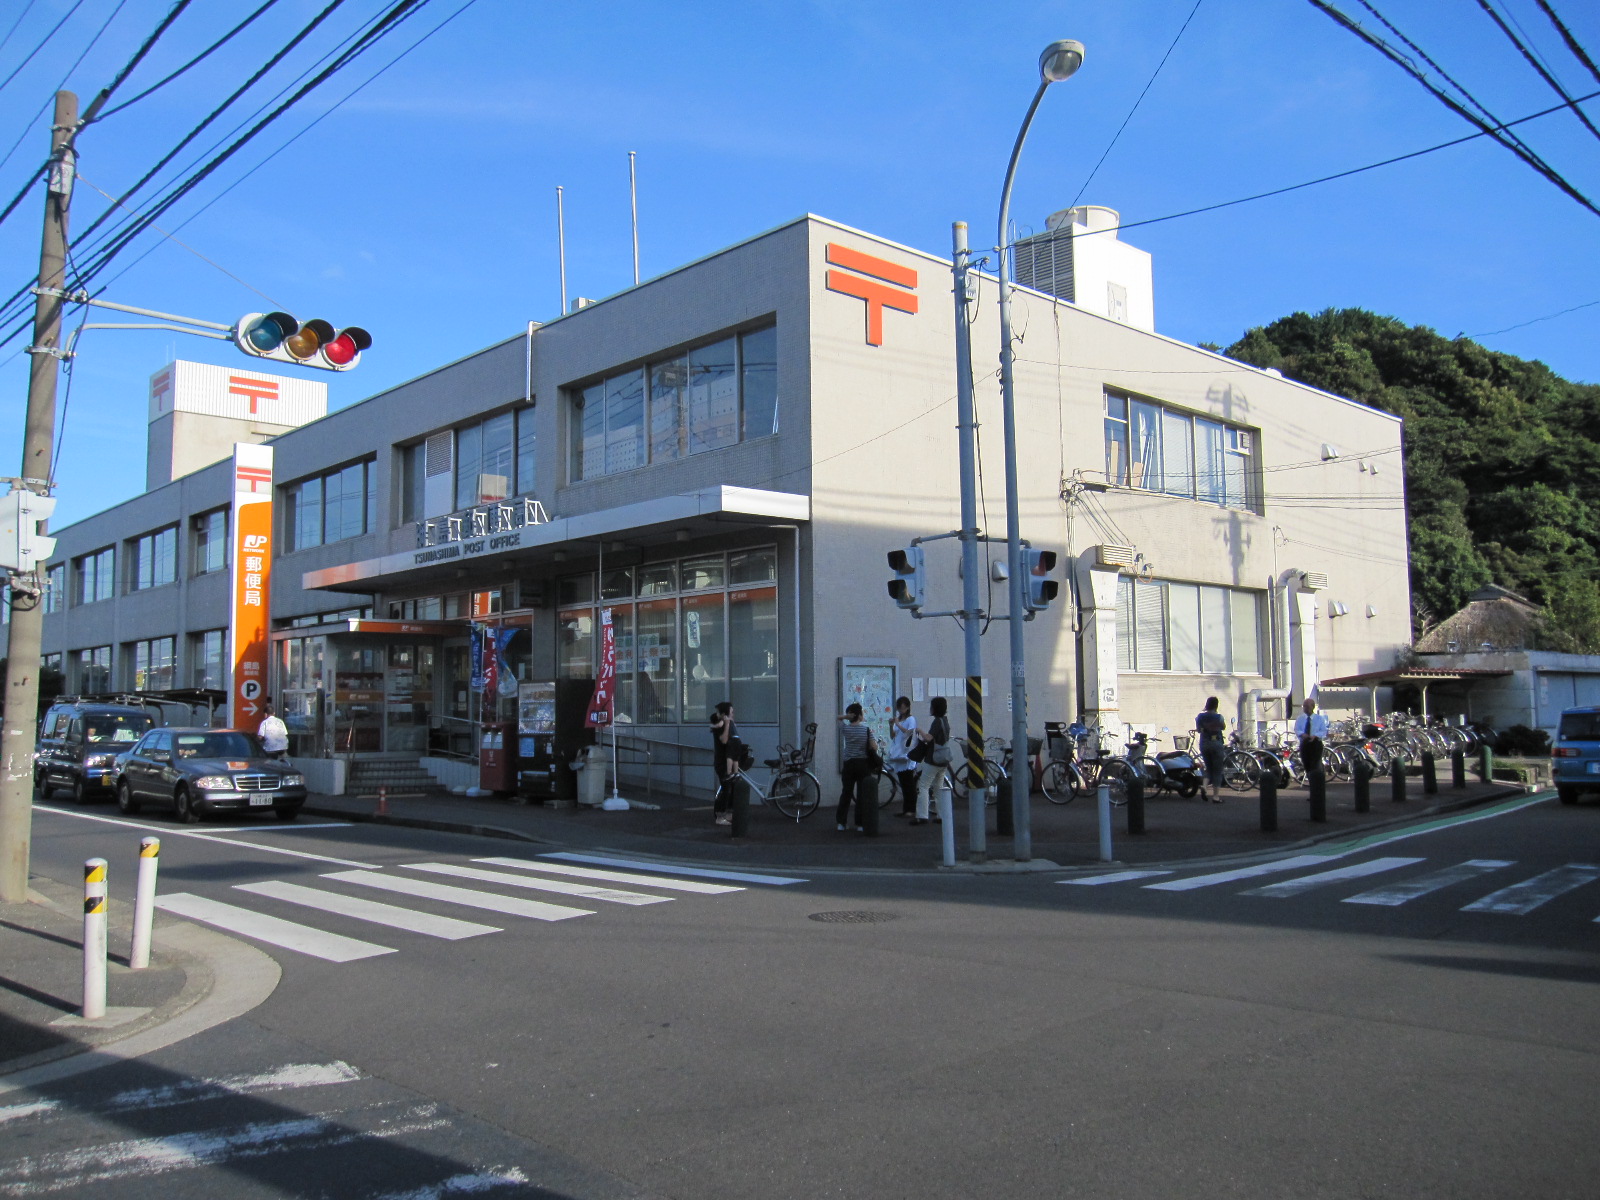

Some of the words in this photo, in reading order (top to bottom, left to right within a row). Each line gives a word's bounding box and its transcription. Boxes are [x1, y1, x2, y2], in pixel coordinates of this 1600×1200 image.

[413, 545, 460, 564] TSUNASHIMA
[463, 540, 486, 554] POST
[489, 533, 520, 550] OFFICE
[244, 556, 262, 607] 郵便局
[246, 683, 257, 697] P
